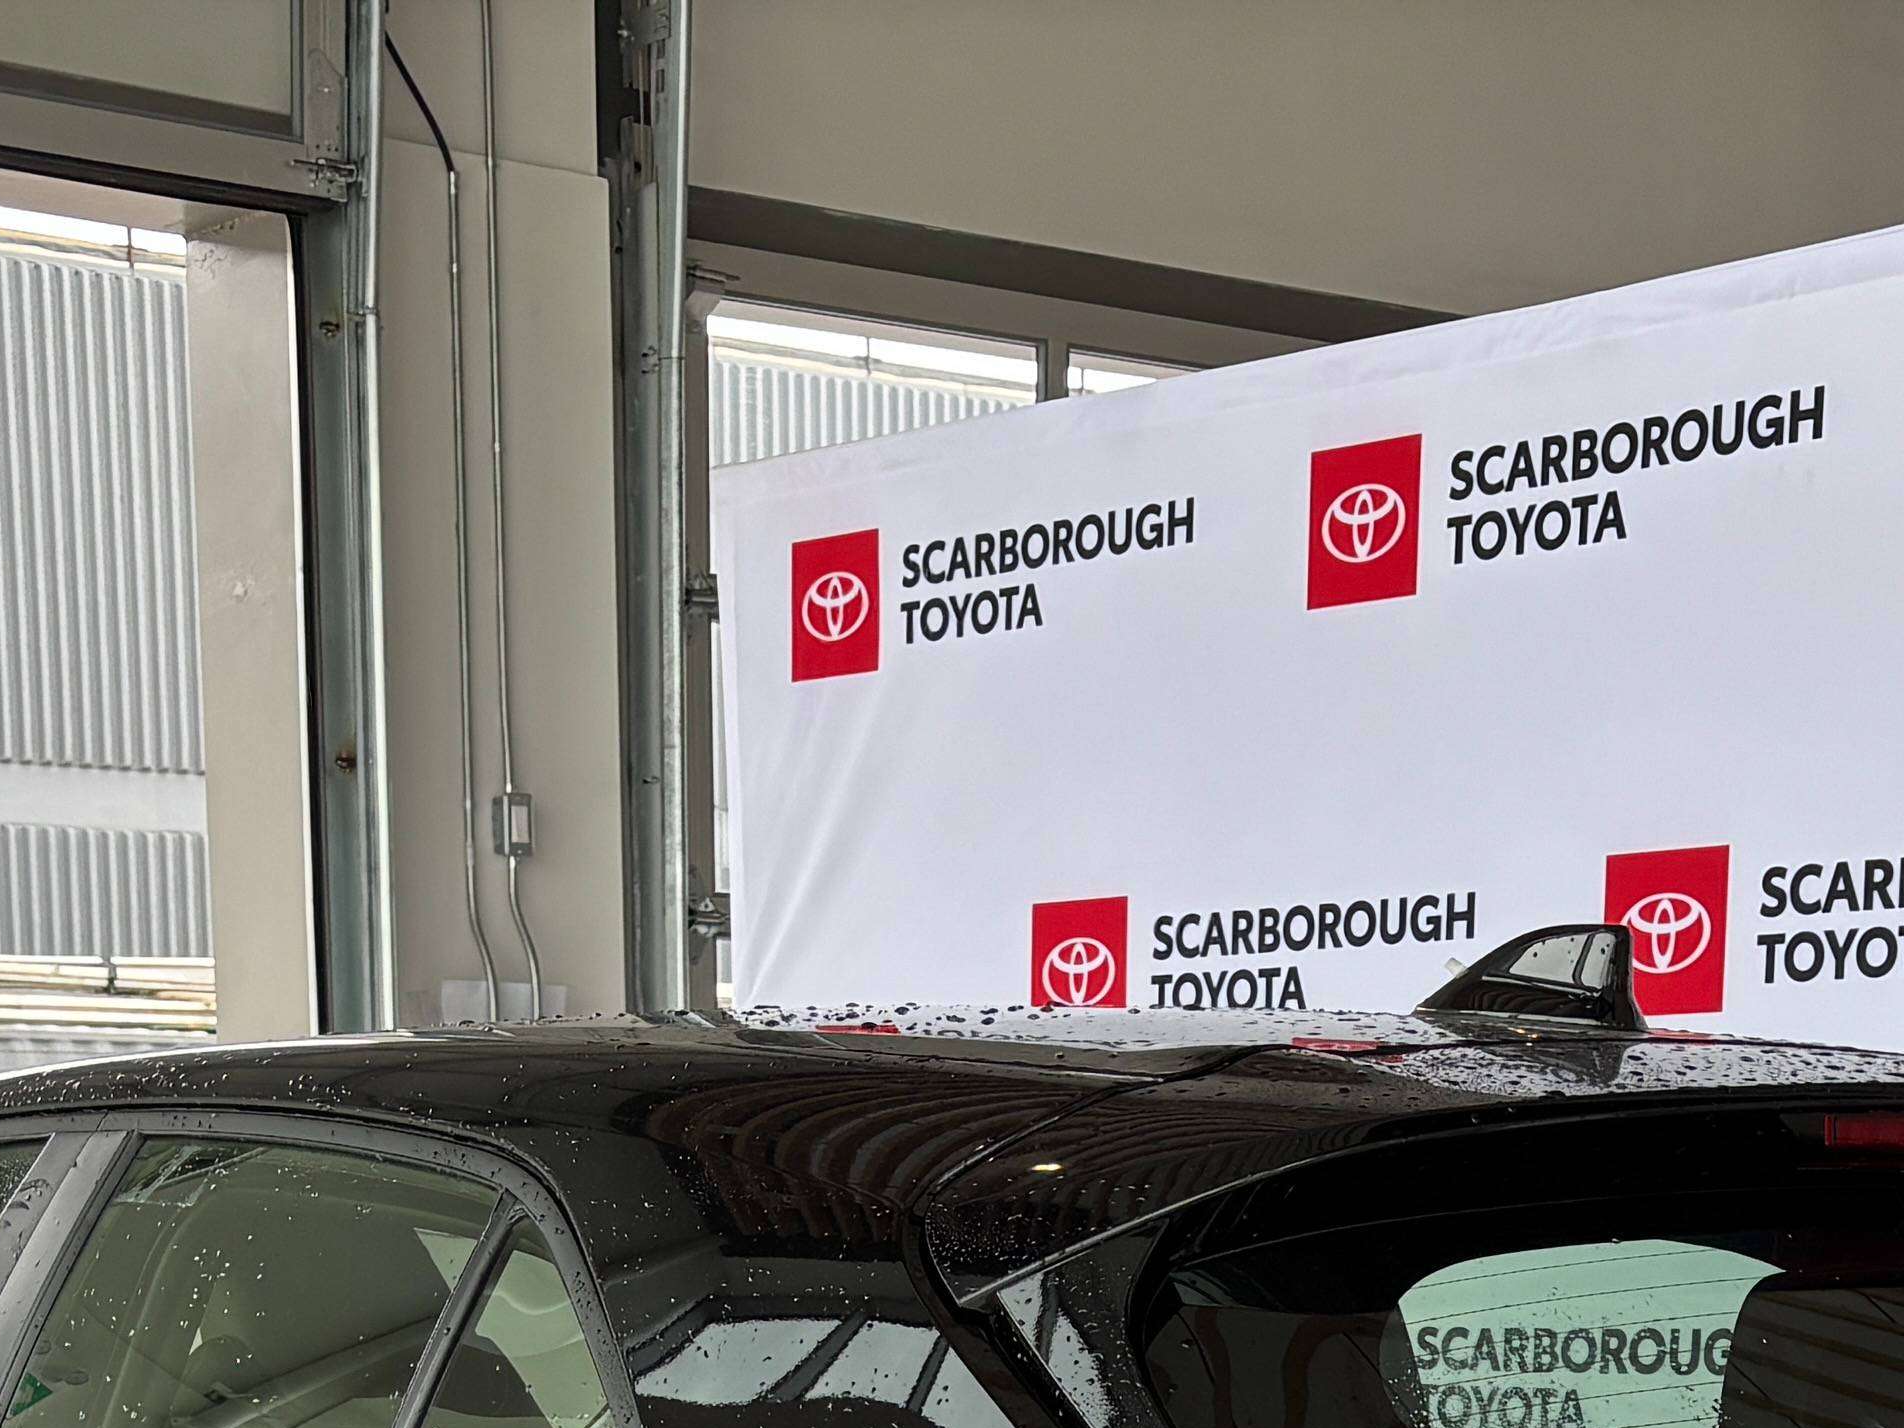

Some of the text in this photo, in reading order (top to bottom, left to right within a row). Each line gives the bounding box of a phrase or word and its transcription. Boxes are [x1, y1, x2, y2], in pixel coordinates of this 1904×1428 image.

[1449, 386, 1825, 501] SCARBOROUGH
[902, 497, 1195, 588] SCARBOROUGH
[1446, 491, 1627, 565] TOYOTA
[900, 585, 1043, 645] TOYOTA
[1152, 892, 1476, 960] SCARBOROUGH
[1151, 966, 1306, 1009] TOYOTA
